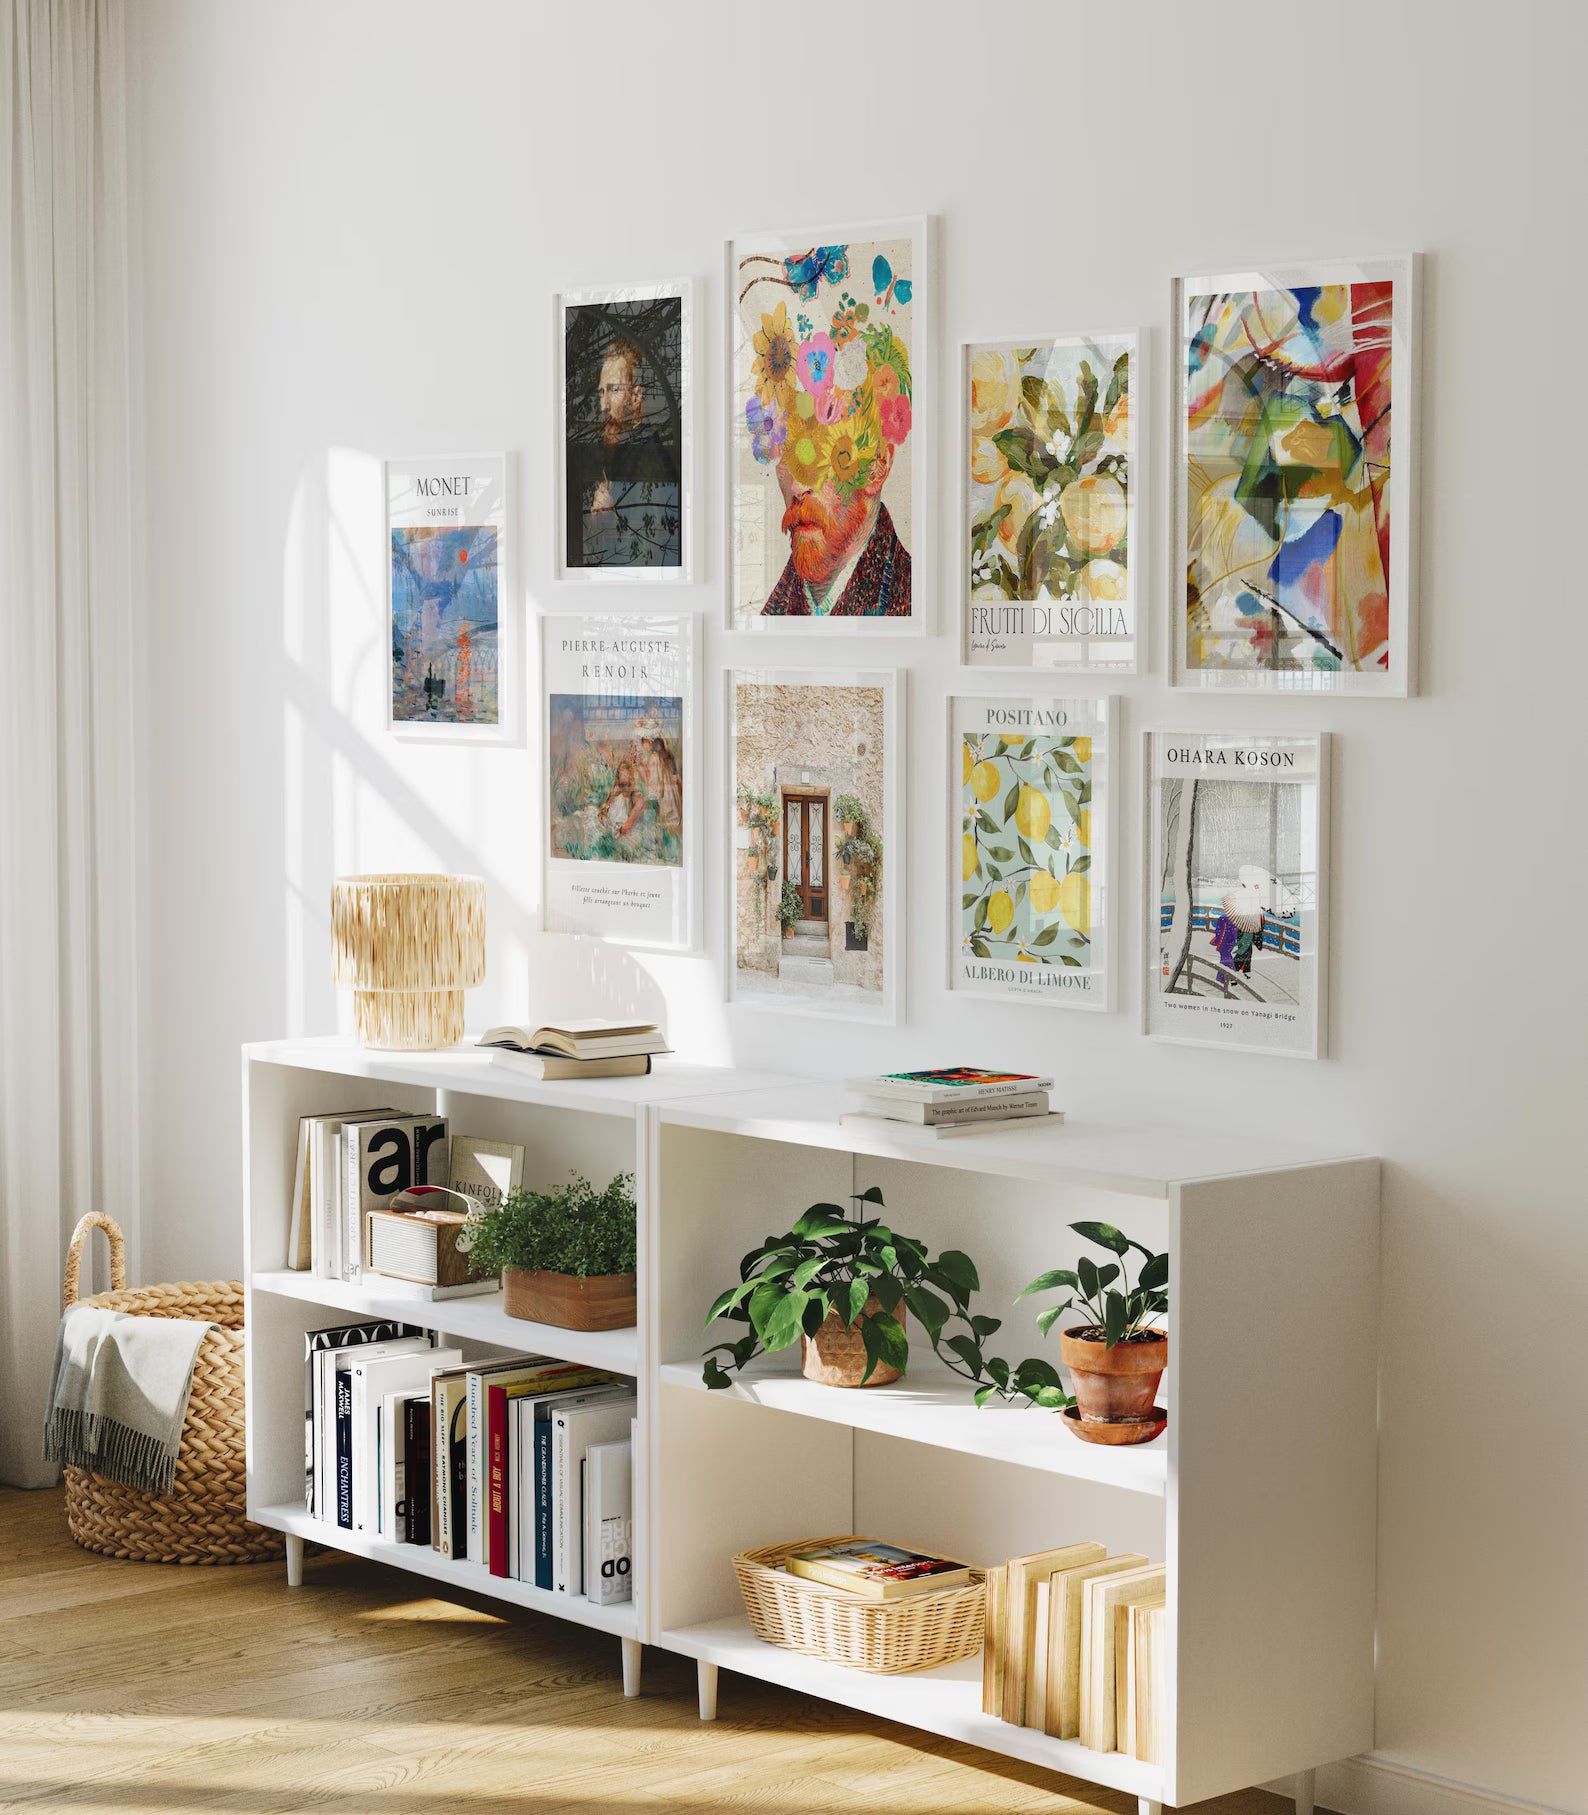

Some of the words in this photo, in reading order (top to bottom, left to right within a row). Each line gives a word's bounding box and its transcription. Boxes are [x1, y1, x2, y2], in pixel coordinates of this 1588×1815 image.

[416, 476, 471, 496] MONET
[426, 507, 459, 517] SUNRISE
[971, 607, 1024, 635] FRUTTI
[1032, 607, 1051, 634] DI
[1059, 606, 1128, 636] SICILIA
[562, 639, 670, 653] PIERRE-AUGUSTE
[582, 665, 648, 679] RENOIR
[986, 708, 1068, 727] POSITANO
[1167, 748, 1227, 764] OHARA
[1234, 750, 1295, 767] KOSON
[962, 964, 1015, 983] ALBERO
[1019, 970, 1033, 985] DI
[1038, 971, 1091, 990] LIMONE
[1164, 1001, 1177, 1009] Two
[1210, 1006, 1220, 1014] the
[1251, 1010, 1273, 1020] Yanagi
[1274, 1012, 1296, 1022] Bridge
[978, 1087, 996, 1096] HENRY
[997, 1085, 1017, 1093] MATISSE
[932, 1108, 941, 1116] The
[941, 1107, 957, 1117] graphic
[970, 1104, 986, 1112] Edvard
[986, 1103, 1002, 1111] Munch
[1002, 1102, 1008, 1111] by
[367, 1124, 445, 1195] ar
[471, 1468, 477, 1483] of
[492, 1466, 502, 1481] BOY
[340, 1456, 349, 1523] ENCHANTRESS
[492, 1490, 502, 1513] ABOUT
